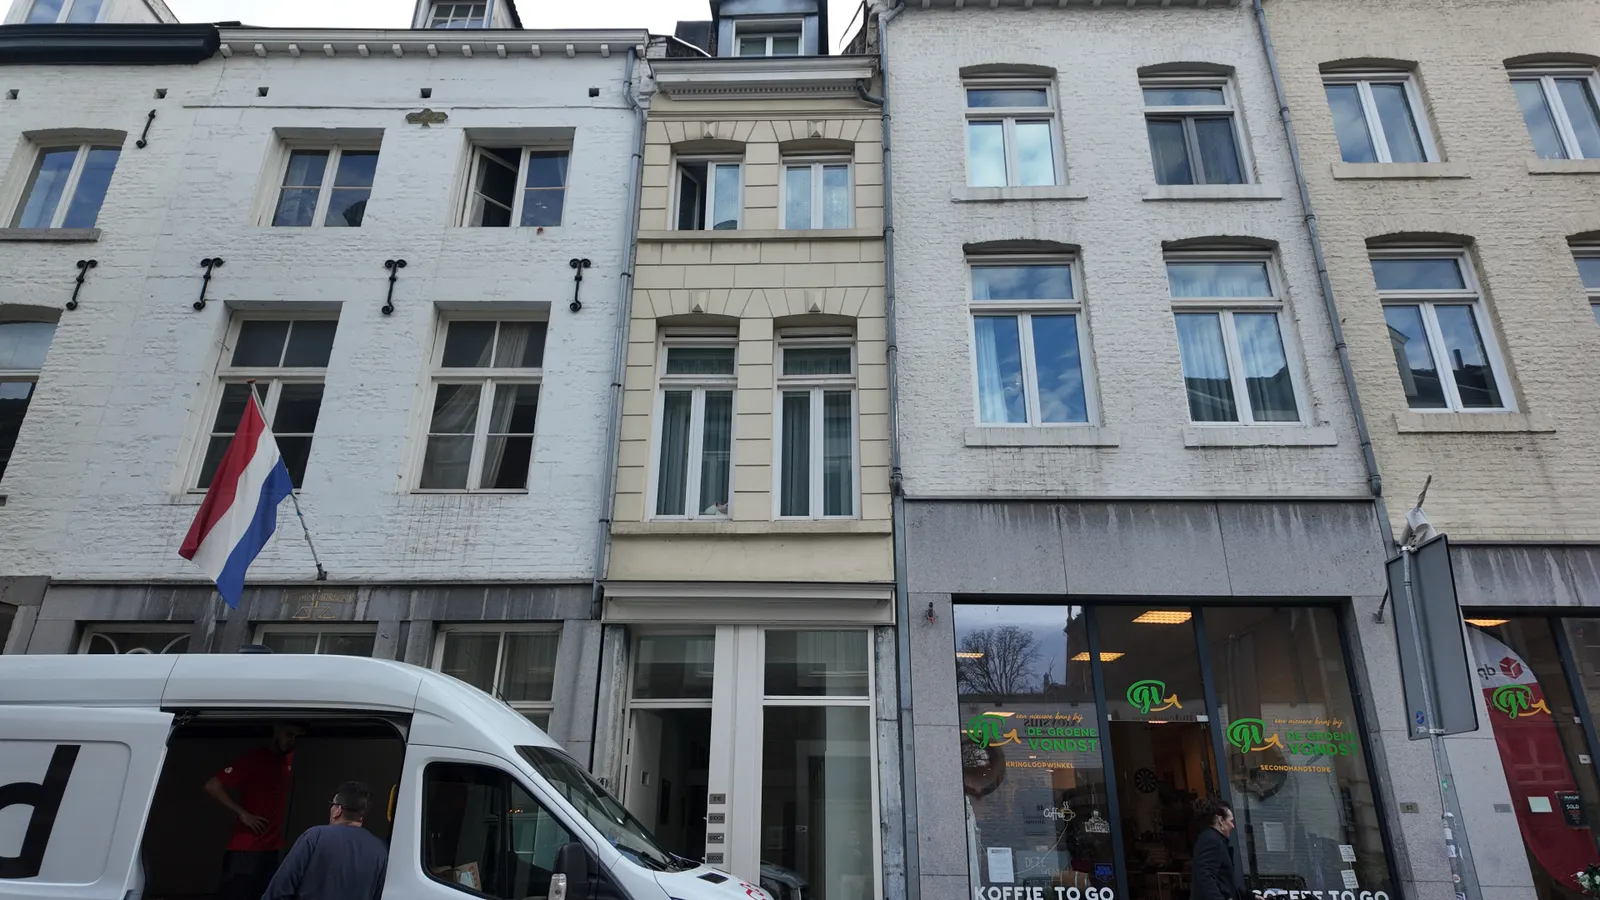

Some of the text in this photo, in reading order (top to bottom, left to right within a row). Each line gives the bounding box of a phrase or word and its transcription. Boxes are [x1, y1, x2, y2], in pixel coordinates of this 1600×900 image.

[1027, 727, 1097, 737] DE GROENE
[1286, 731, 1357, 742] DE GROENE
[1027, 738, 1097, 752] VONDST
[1288, 743, 1358, 756] VONDST
[1005, 761, 1075, 769] KRINGLOOPWINKEL
[1259, 764, 1332, 773] SECONDHANDSTORE
[975, 886, 1114, 900] KOFFIE TO GO
[1328, 890, 1355, 900] TO
[1359, 890, 1390, 900] GO
